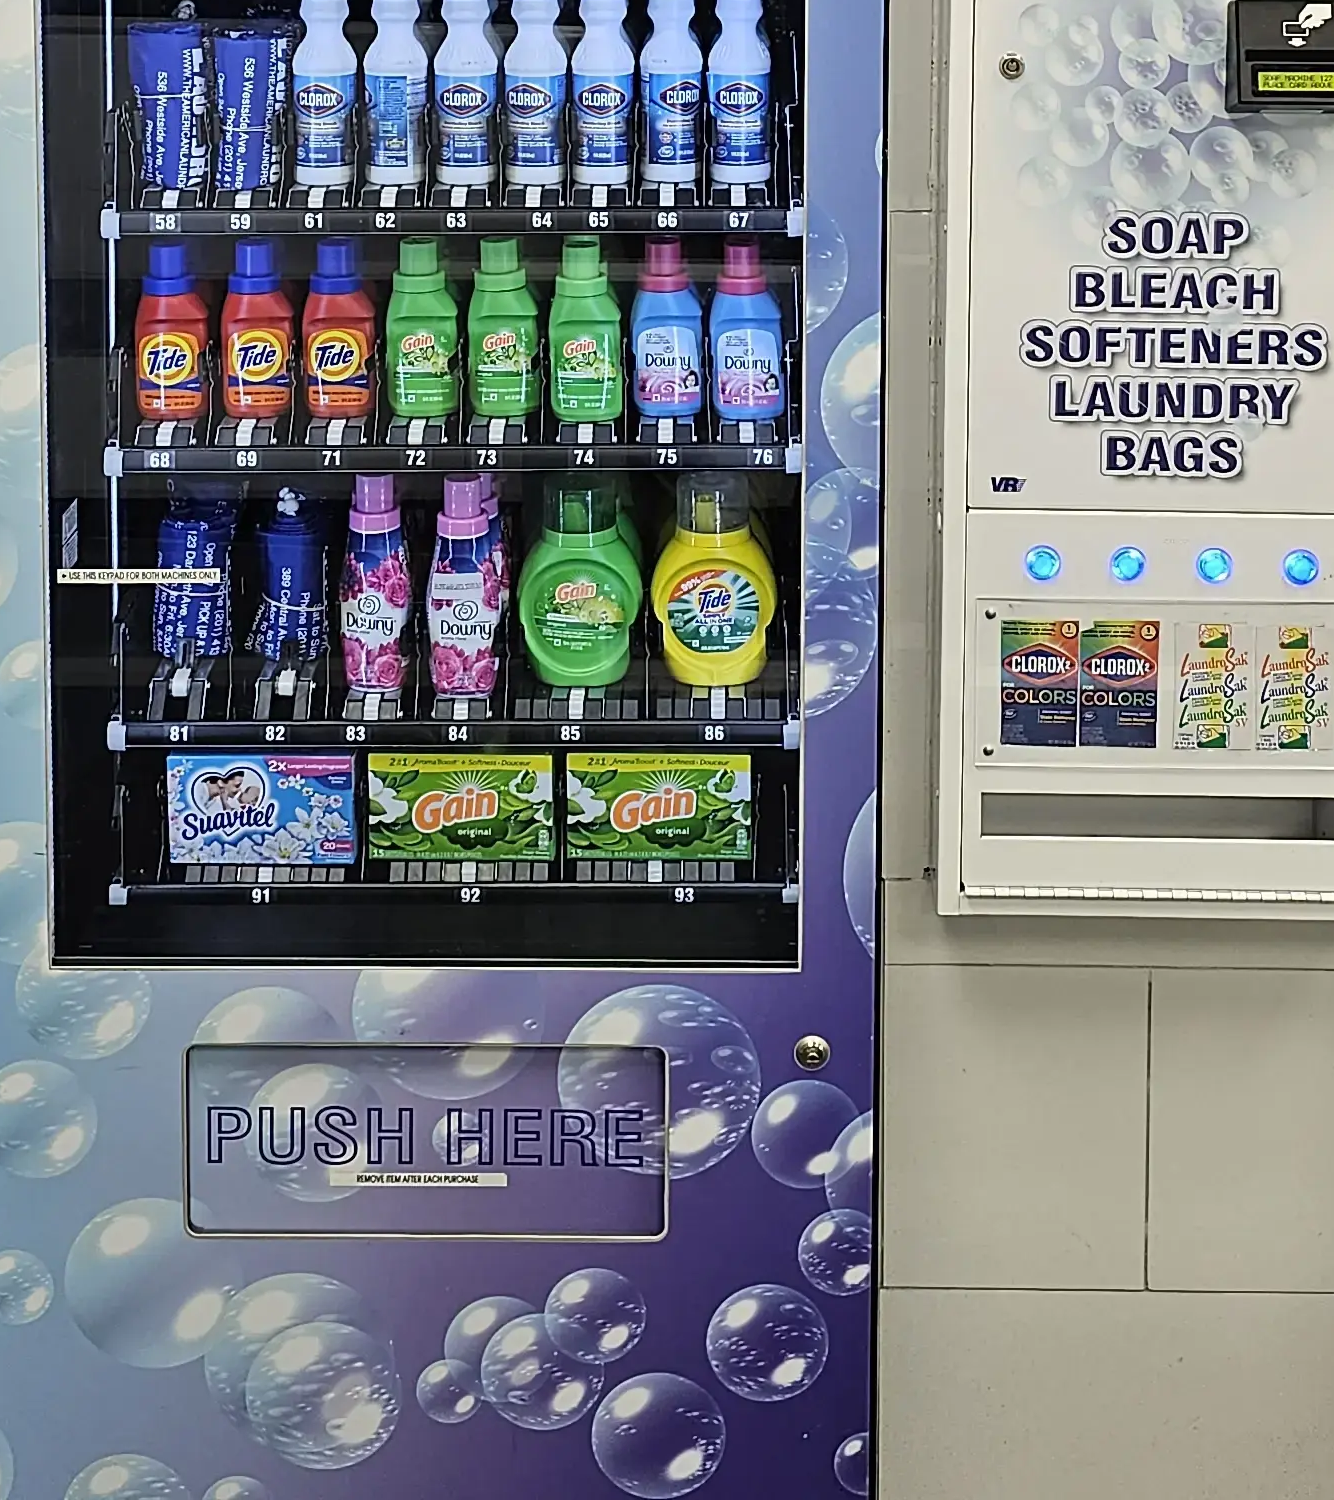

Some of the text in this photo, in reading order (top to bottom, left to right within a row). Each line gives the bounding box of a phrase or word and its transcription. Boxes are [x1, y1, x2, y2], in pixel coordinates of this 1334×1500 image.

[244, 57, 256, 79] 536
[299, 91, 338, 107] CLOROX
[443, 91, 482, 107] CLOROX
[508, 91, 546, 107] CLOROX
[582, 91, 621, 106] CLOROX
[719, 90, 760, 105] CLOROX
[154, 212, 176, 230] 58
[230, 213, 251, 230] 59
[304, 212, 323, 229] 61
[375, 212, 396, 229] 62
[446, 212, 467, 229] 63
[531, 211, 553, 228] 64
[588, 211, 609, 228] 65
[657, 211, 678, 228] 66
[729, 211, 750, 228] 67
[1106, 214, 1245, 256] SOAP
[1073, 270, 1276, 311] BLEACH
[401, 333, 434, 352] Gain
[483, 332, 516, 351] Gain
[563, 340, 596, 358] Gain
[1024, 324, 1323, 367] SOFTENERS
[147, 348, 189, 375] Tide
[236, 345, 277, 372] Tide
[314, 344, 355, 371] Tide
[645, 353, 692, 376] Downy
[724, 354, 772, 376] Downy
[1054, 379, 1295, 421] LAUNDRY
[149, 451, 170, 468] 68
[236, 450, 258, 467] 69
[321, 449, 341, 466] 71
[405, 449, 426, 466] 72
[476, 449, 497, 466] 73
[573, 448, 595, 465] 74
[656, 448, 678, 465] 75
[752, 448, 773, 465] 76
[1105, 434, 1240, 474] BAGS
[555, 581, 598, 602] Gain
[698, 588, 732, 614] Tide
[346, 612, 395, 637] Downy
[440, 619, 493, 641] Downy
[1002, 689, 1076, 705] COLORS
[1081, 691, 1156, 707] COLORS
[412, 787, 499, 834] Gain
[610, 787, 698, 833] Gain
[180, 802, 276, 841] Suavitel
[457, 826, 492, 838] original
[655, 826, 690, 837] original
[251, 887, 270, 904] 91
[460, 887, 481, 903] 92
[674, 887, 695, 903] 93
[205, 1105, 645, 1168] PUSH HERE
